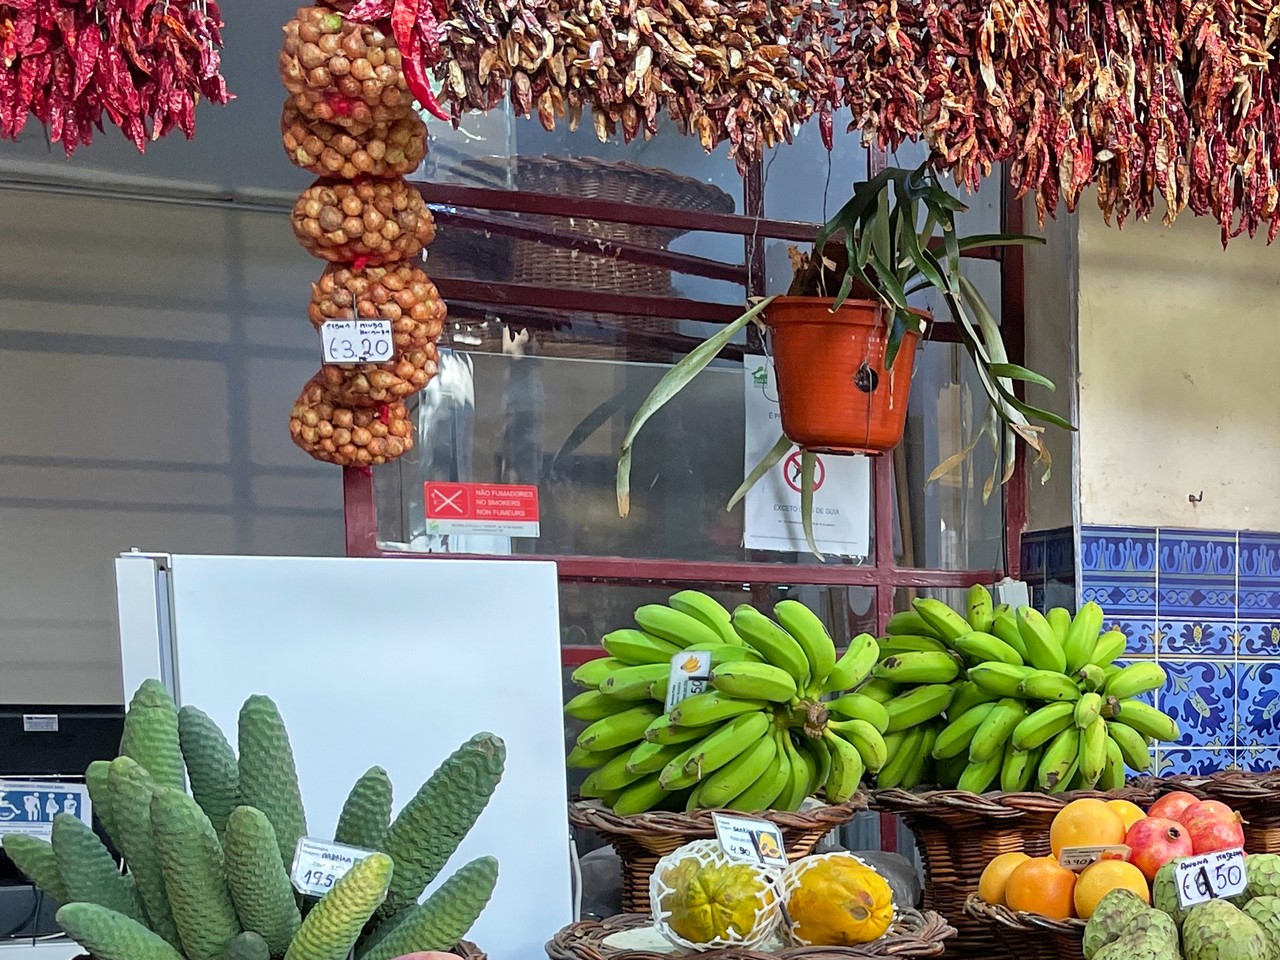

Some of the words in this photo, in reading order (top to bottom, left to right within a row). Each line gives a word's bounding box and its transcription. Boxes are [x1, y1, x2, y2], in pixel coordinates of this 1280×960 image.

[475, 489, 491, 498] NÃO
[492, 490, 534, 499] FUMADORES
[488, 499, 521, 507] SMOKERS
[773, 504, 798, 513] EXCETO
[815, 507, 824, 515] DE
[825, 507, 840, 516] GUIA
[1180, 858, 1209, 870] ANONA
